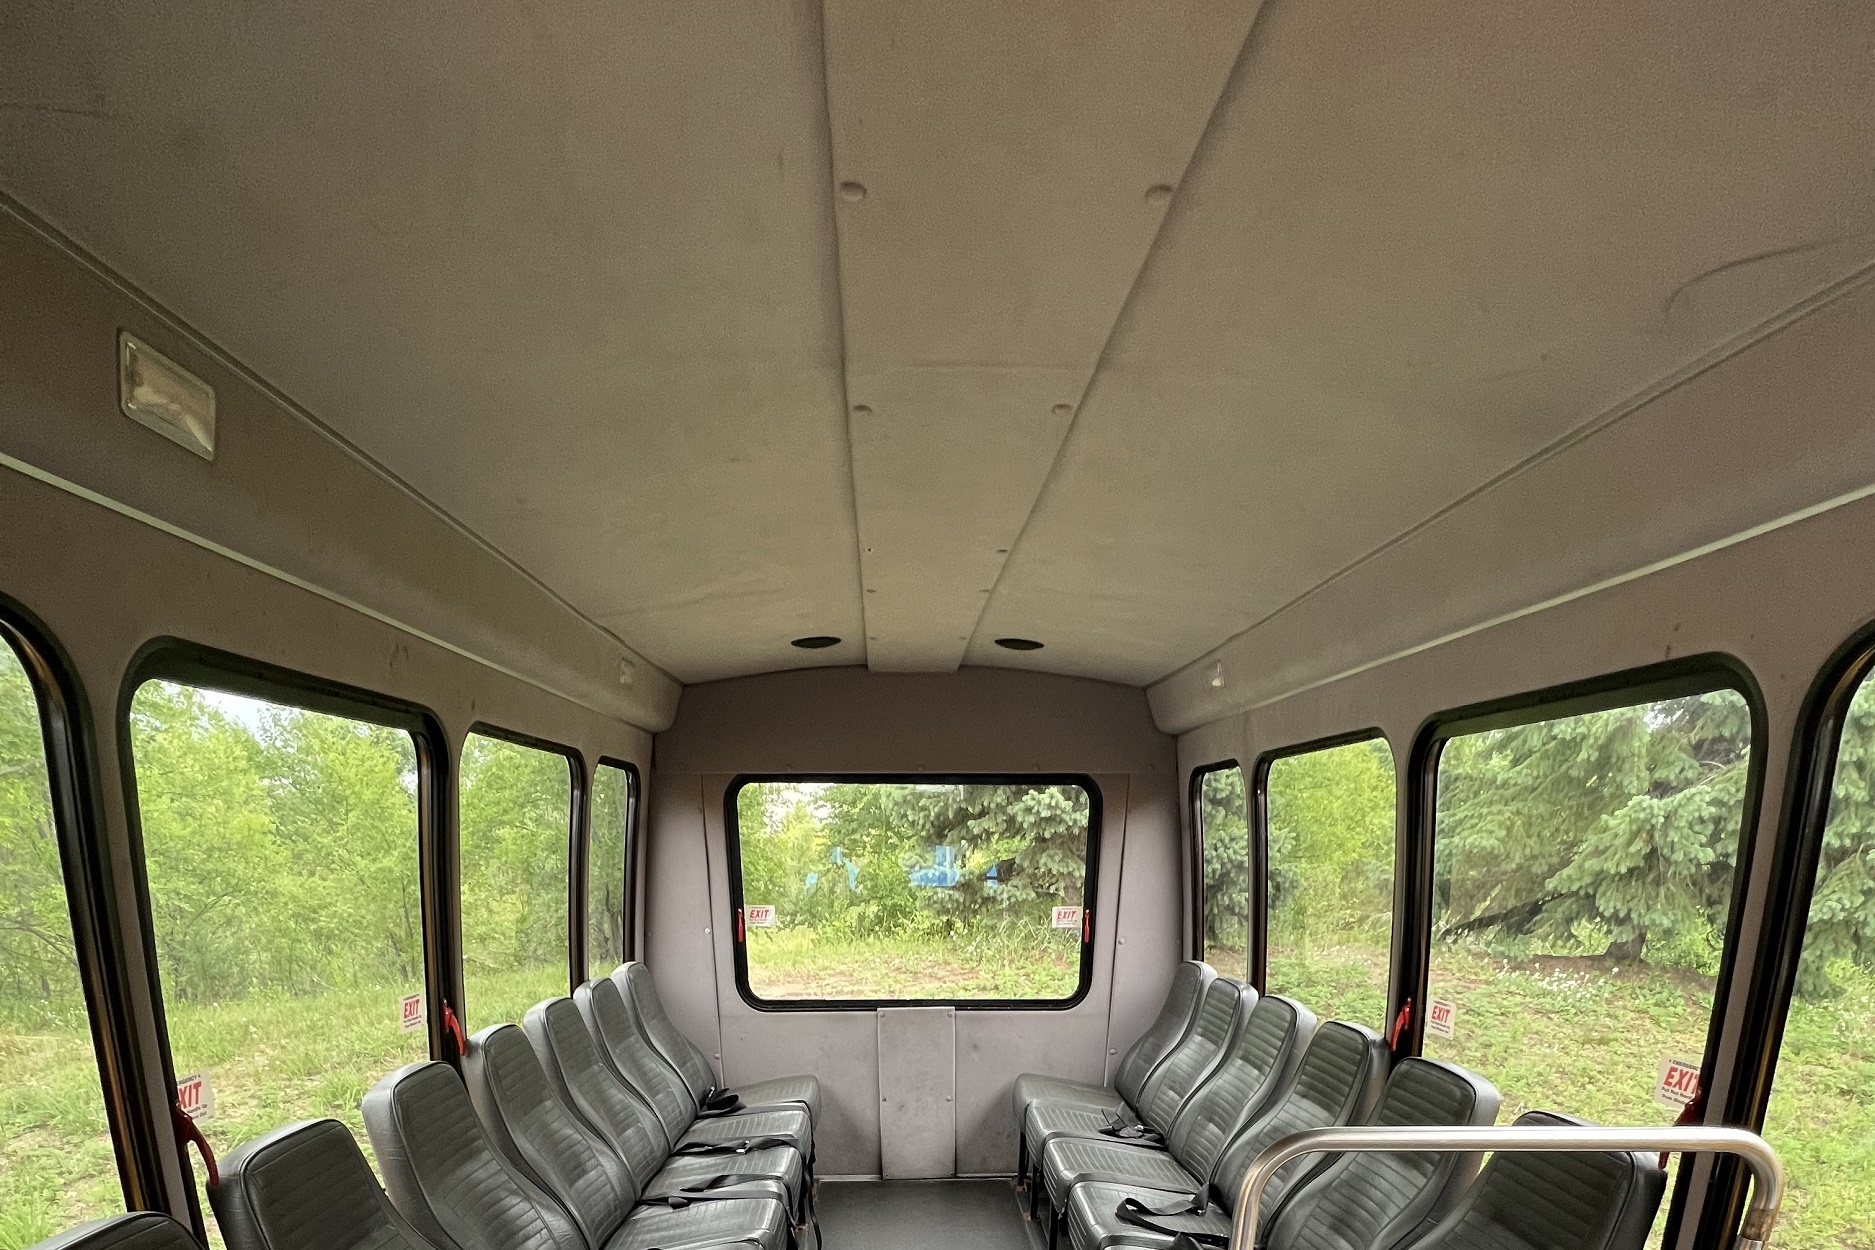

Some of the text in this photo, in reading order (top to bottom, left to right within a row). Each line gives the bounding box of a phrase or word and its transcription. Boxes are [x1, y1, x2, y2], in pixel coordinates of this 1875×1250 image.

[750, 909, 770, 919] EXIT
[1057, 910, 1077, 920] EXIT
[403, 998, 420, 1019] EXIT
[1431, 1004, 1451, 1024] EXIT
[1672, 1059, 1699, 1071] EMERGENC
[178, 1080, 202, 1109] XIT
